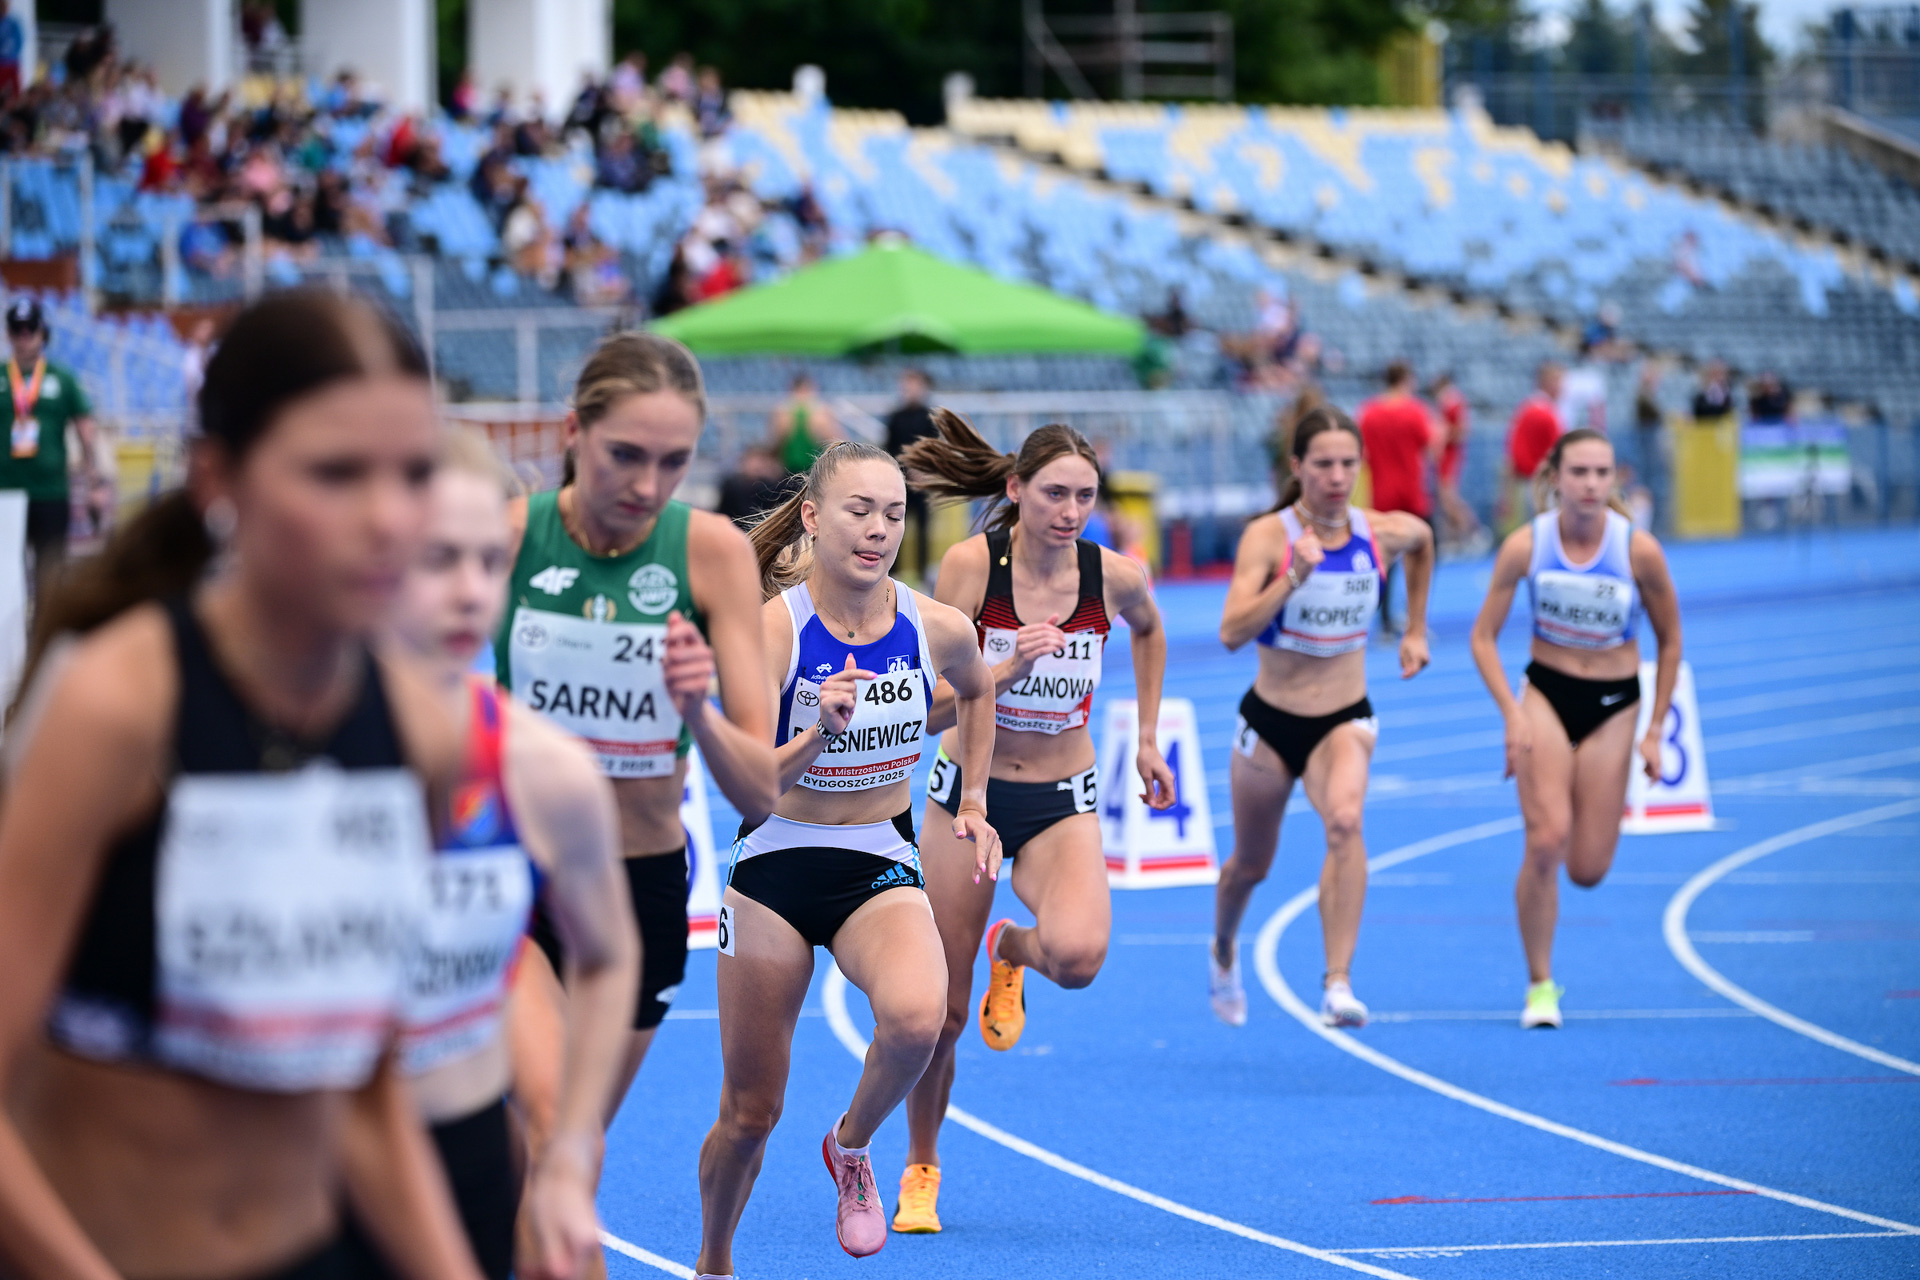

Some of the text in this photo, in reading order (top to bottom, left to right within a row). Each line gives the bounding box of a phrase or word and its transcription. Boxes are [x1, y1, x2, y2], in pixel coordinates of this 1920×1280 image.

[613, 634, 667, 665] 24
[529, 680, 657, 721] SARNA
[864, 678, 912, 706] 486
[803, 770, 905, 788] BYDGOSZCZ 2025
[811, 755, 915, 776] PZLA Mistrzostwa Polski
[930, 758, 948, 793] 5
[1083, 771, 1097, 806] 5
[719, 906, 729, 950] 6
